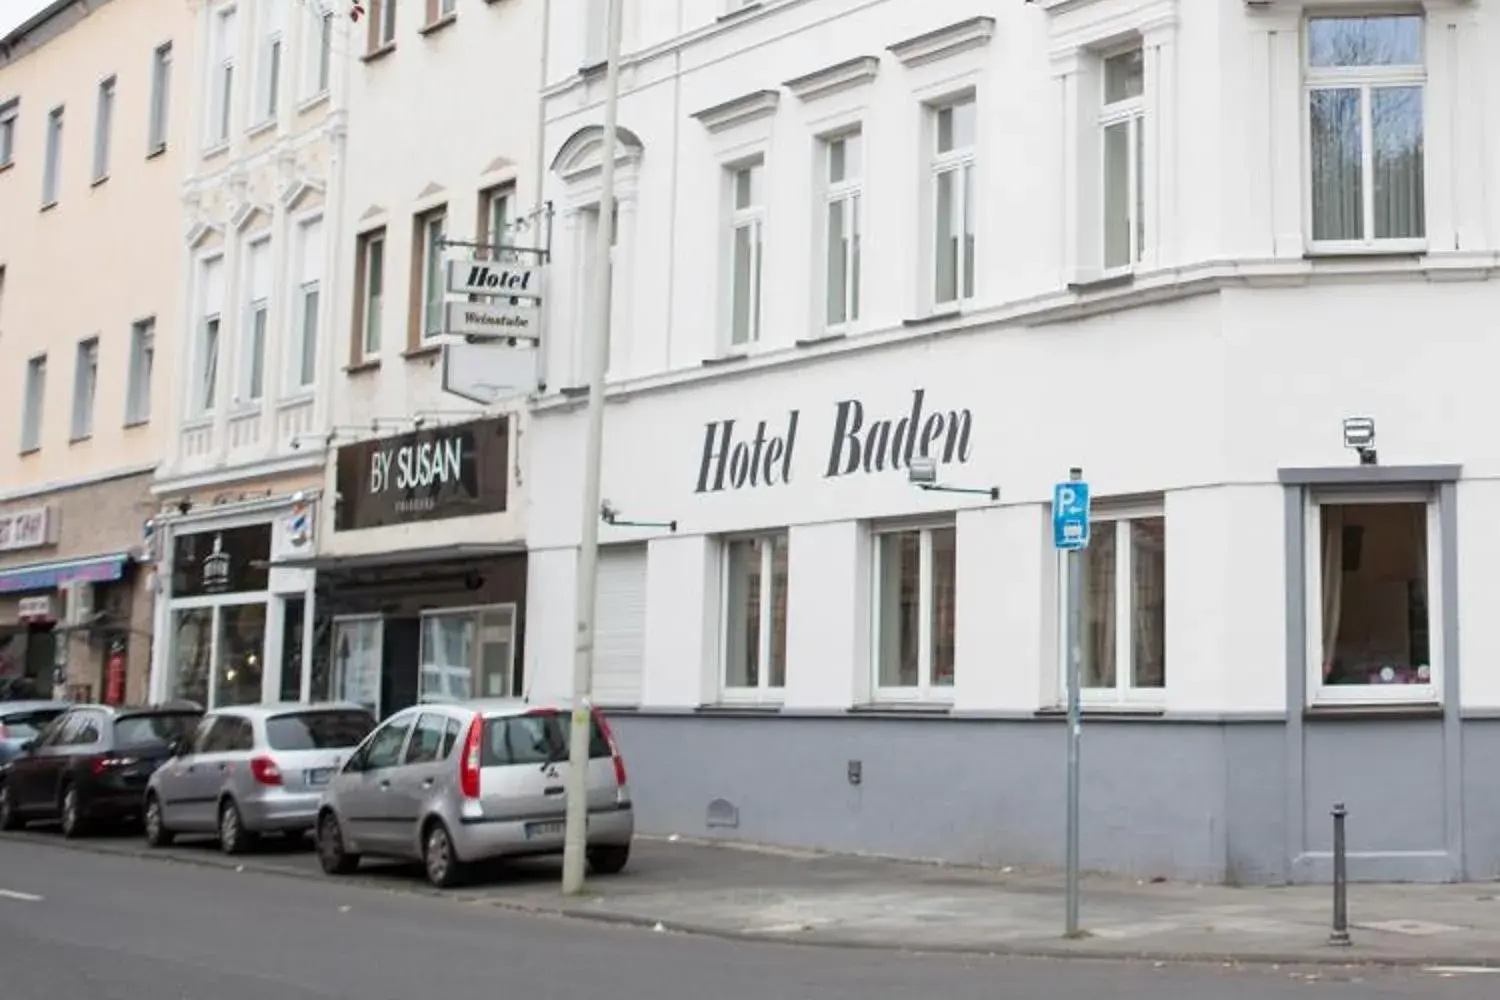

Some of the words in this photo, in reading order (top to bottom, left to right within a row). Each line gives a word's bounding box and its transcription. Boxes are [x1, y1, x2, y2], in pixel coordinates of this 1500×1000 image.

[467, 266, 531, 290] Hotel
[465, 311, 529, 328] Weinstube
[695, 409, 800, 493] Hotel
[823, 388, 973, 478] Baden
[371, 449, 393, 493] BY
[397, 437, 462, 489] SUSAN
[1059, 487, 1076, 515] P
